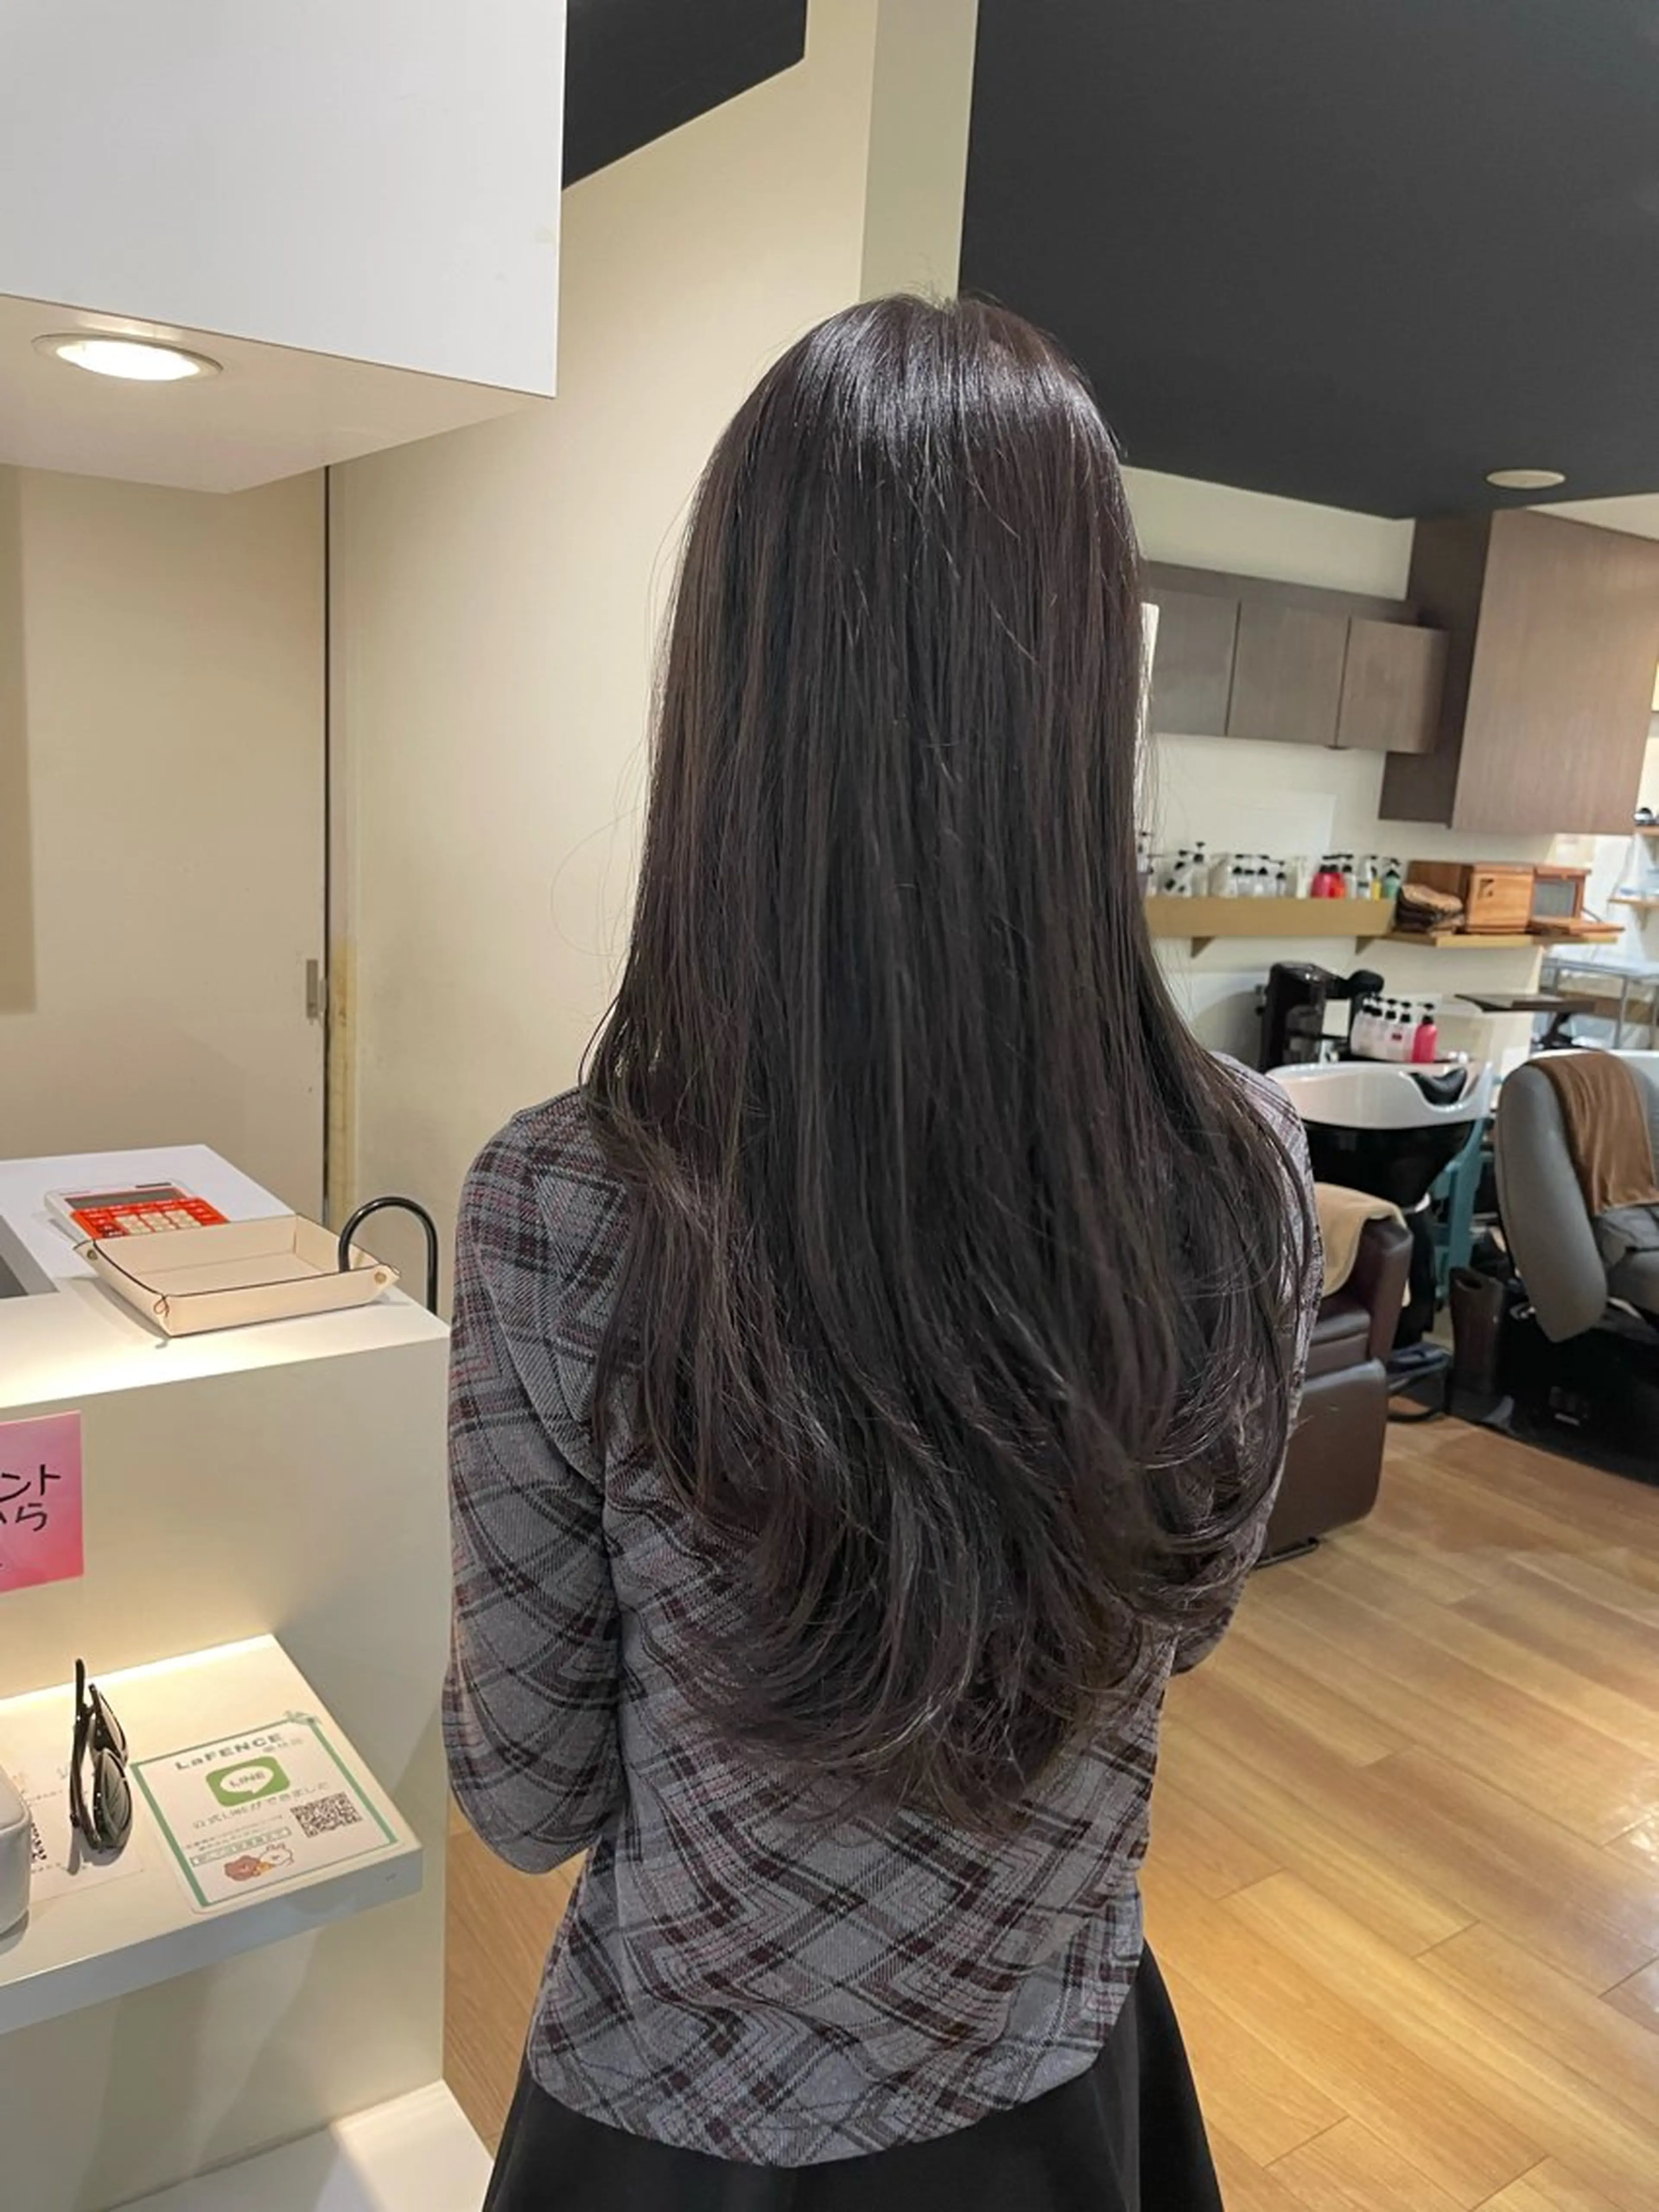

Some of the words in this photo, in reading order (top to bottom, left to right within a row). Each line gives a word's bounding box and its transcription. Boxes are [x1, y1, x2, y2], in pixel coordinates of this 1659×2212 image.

[0, 1502, 47, 1532] ら
[175, 1732, 282, 1770] LaFENCE
[229, 1770, 266, 1788] LINE
